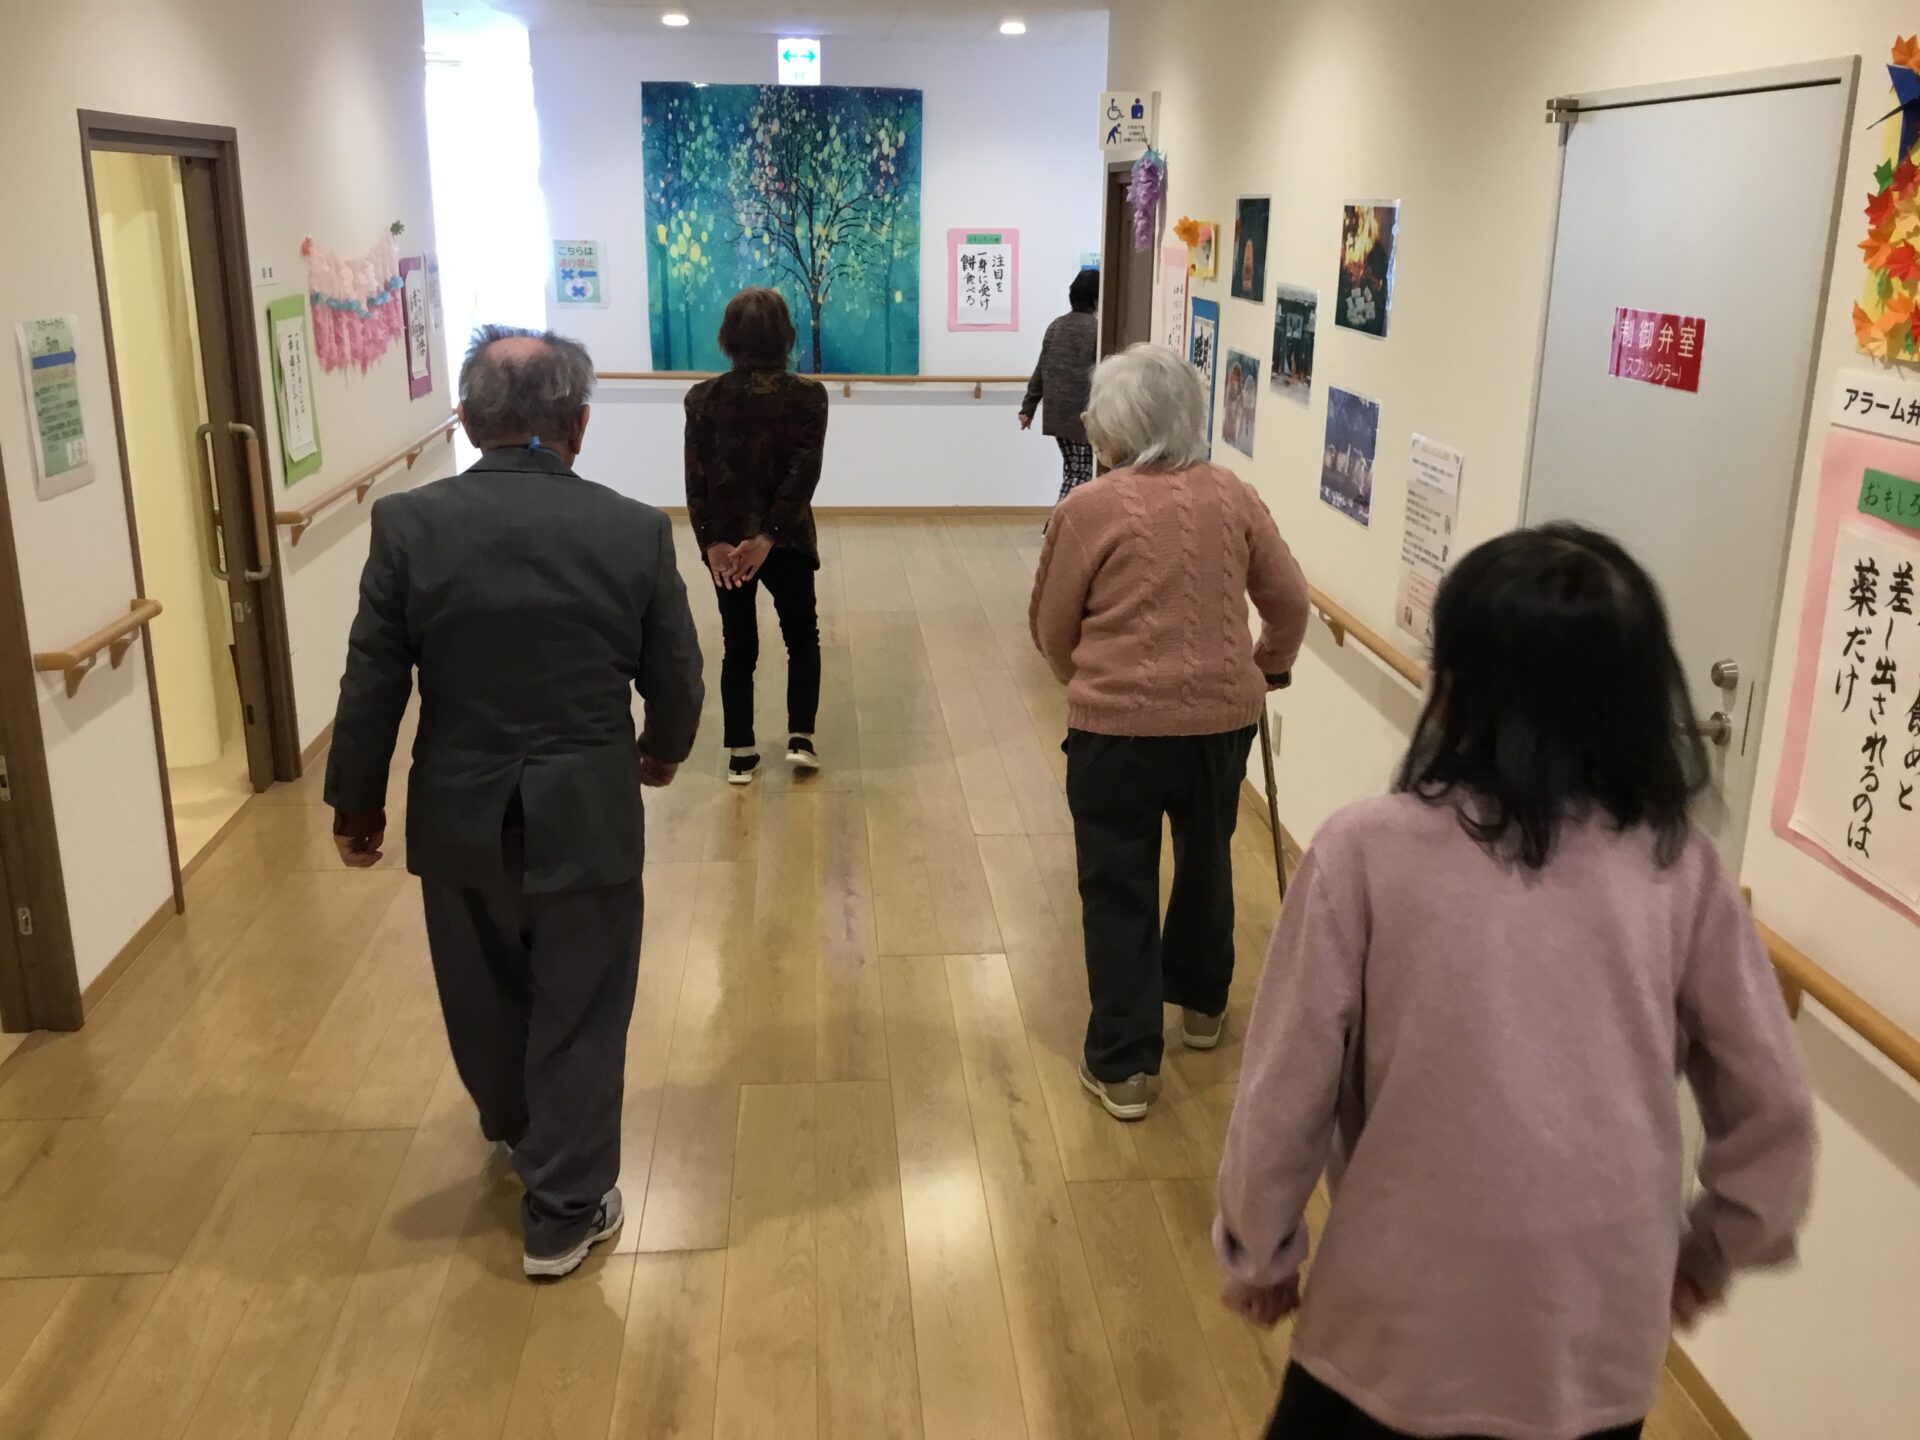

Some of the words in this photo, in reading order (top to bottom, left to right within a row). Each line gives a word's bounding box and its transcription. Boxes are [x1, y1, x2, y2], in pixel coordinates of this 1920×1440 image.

[992, 254, 1006, 293] 注目を
[1620, 318, 1697, 358] 制御弁室
[1835, 557, 1880, 713] 薬だけ
[1847, 561, 1914, 859] 差し出されるのは
